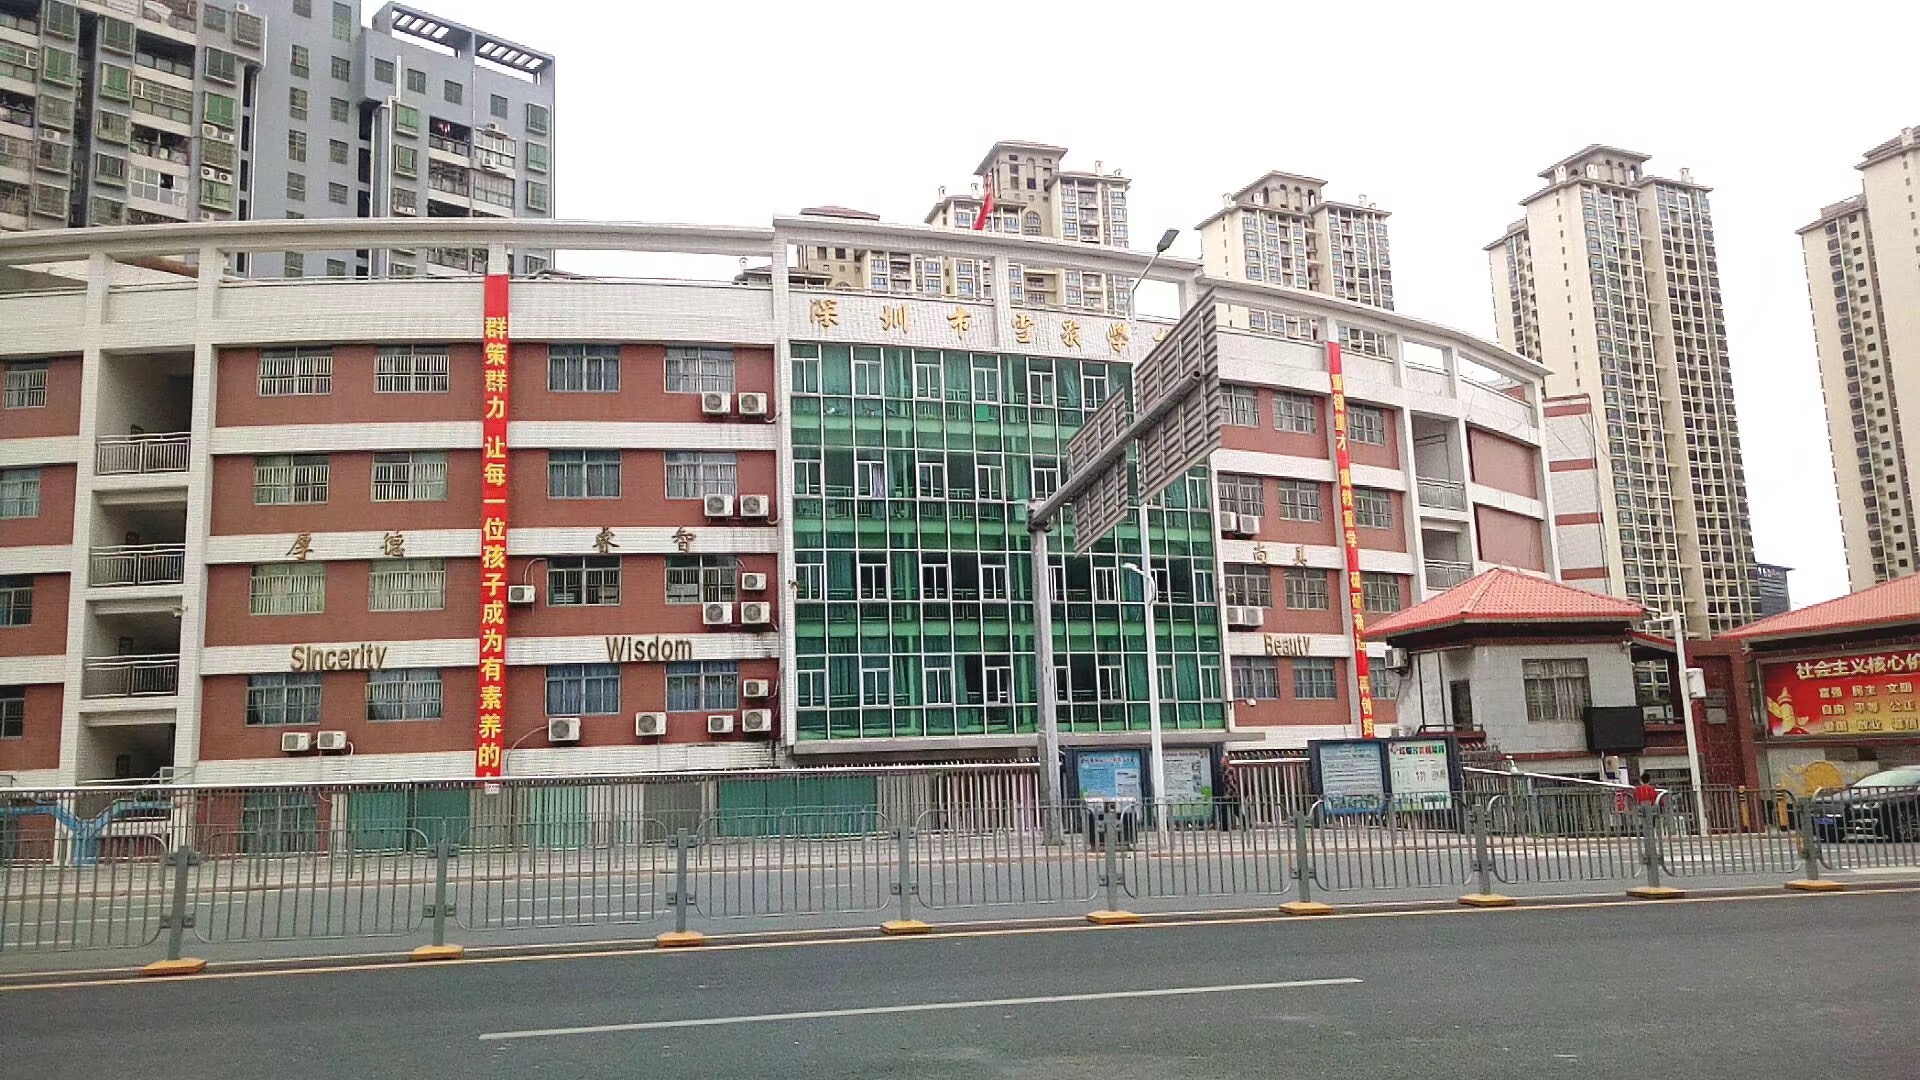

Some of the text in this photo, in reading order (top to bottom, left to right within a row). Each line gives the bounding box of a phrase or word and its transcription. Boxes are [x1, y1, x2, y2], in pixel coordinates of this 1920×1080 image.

[478, 316, 508, 777] 群策群力 让每一位孩子成为有素养的
[290, 643, 388, 671] Sincerity
[605, 636, 693, 662] Wisdom
[1264, 633, 1312, 656] Beauty
[1885, 682, 1912, 693] 文明
